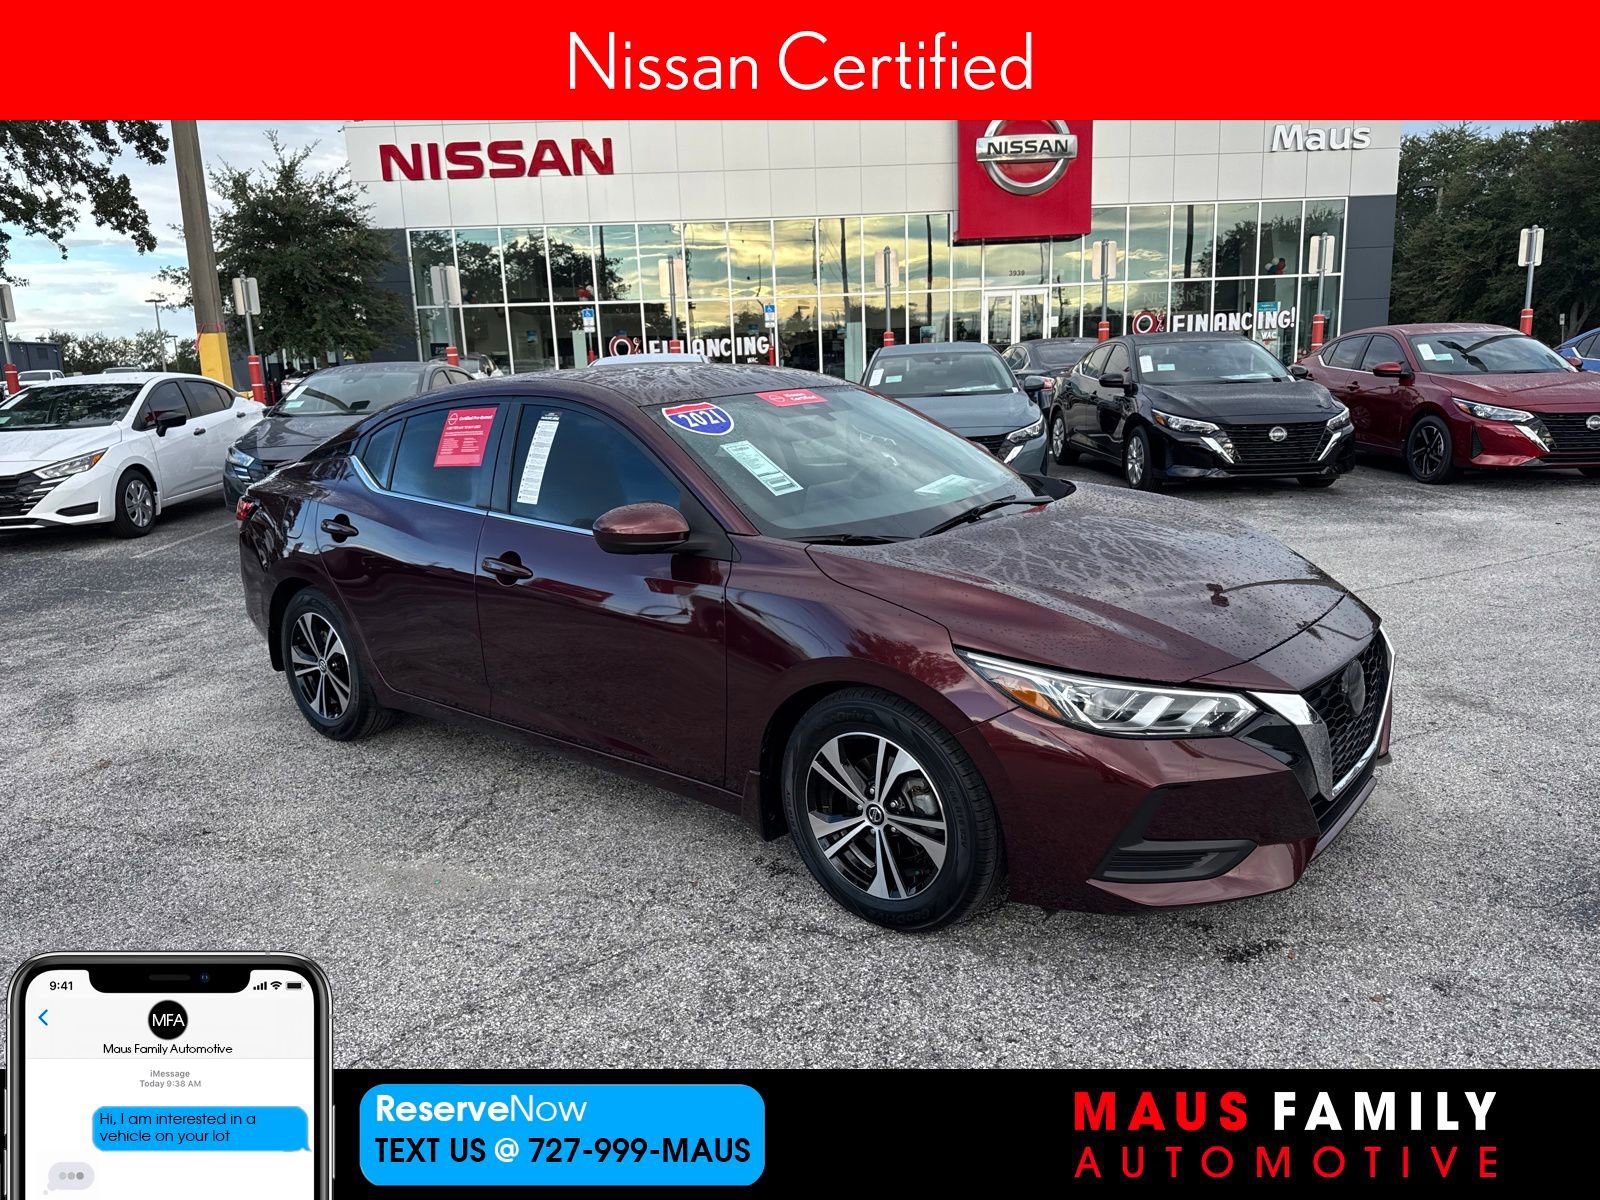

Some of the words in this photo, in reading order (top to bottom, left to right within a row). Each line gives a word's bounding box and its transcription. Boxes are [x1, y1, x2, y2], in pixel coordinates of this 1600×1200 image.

[987, 139, 1068, 155] NISSAN
[1271, 124, 1371, 152] Maus
[379, 138, 614, 181] NISSAN
[1008, 269, 1025, 277] 3939
[1172, 306, 1296, 332] FINANCING!
[1261, 331, 1277, 339] WAC
[679, 410, 726, 428] 2021
